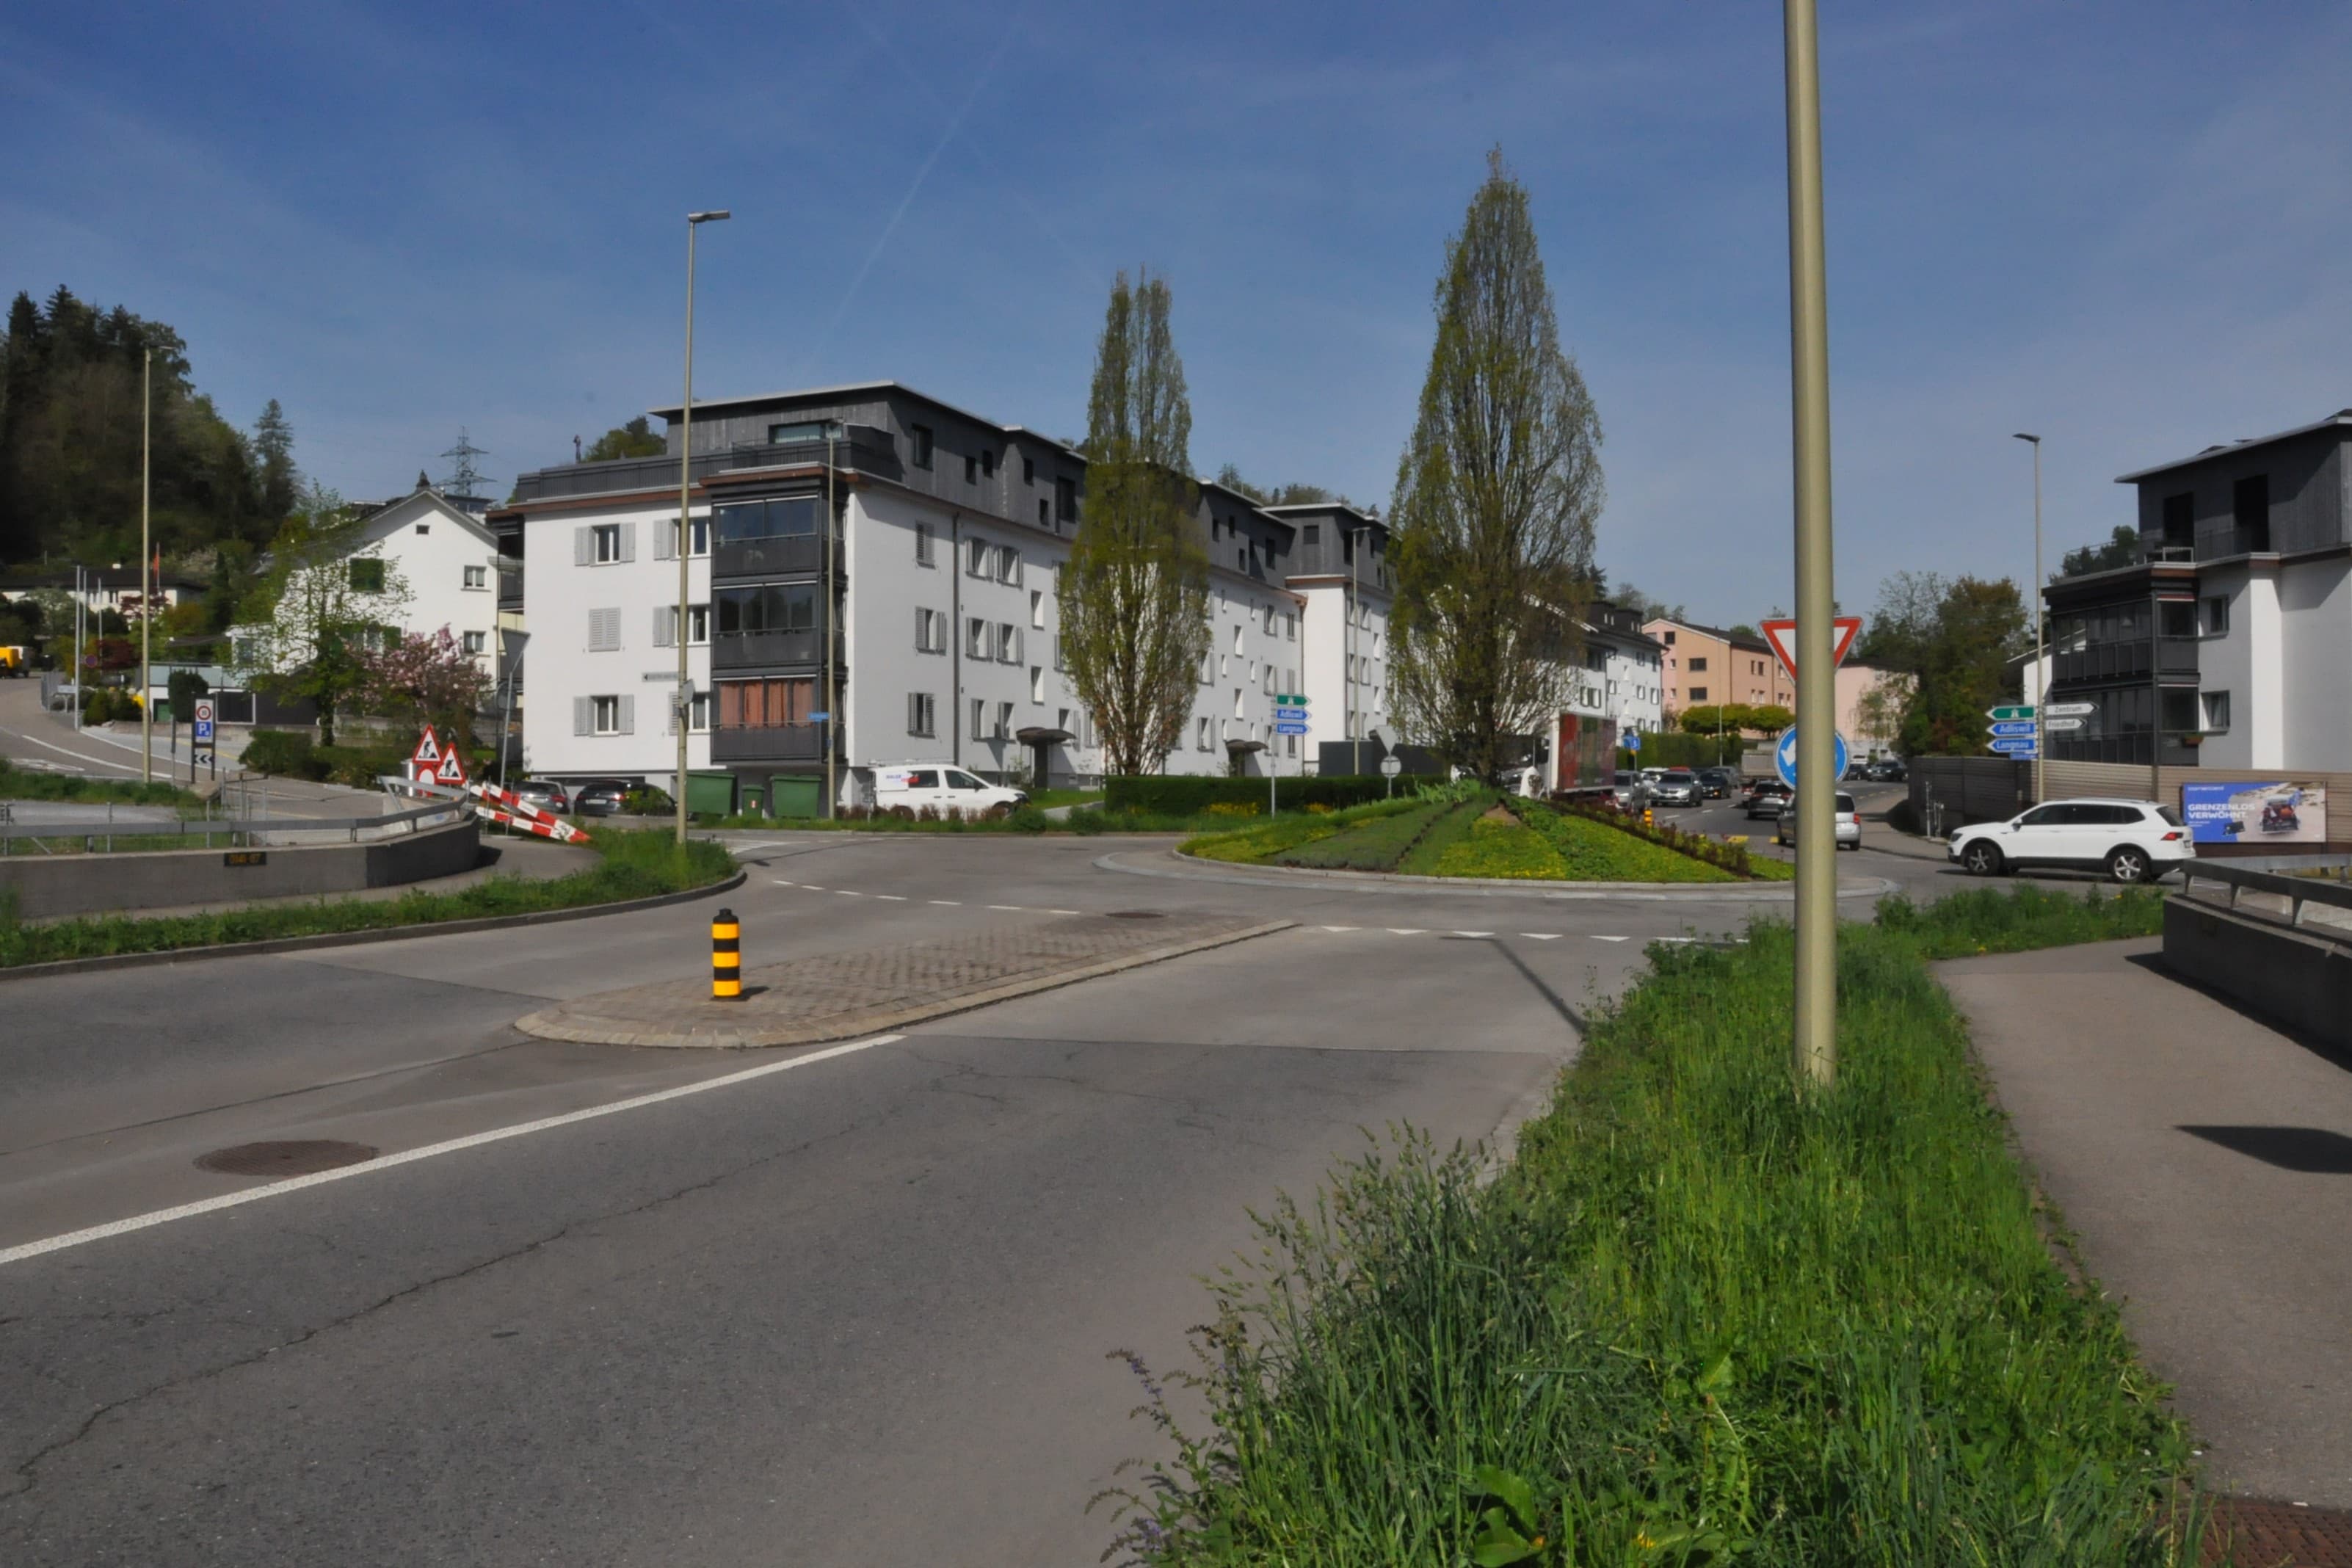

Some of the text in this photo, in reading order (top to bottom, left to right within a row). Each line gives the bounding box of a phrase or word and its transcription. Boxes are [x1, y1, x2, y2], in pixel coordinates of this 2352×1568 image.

[1280, 710, 1303, 718] Adliswil
[1999, 723, 2030, 733] Adliswil
[2048, 720, 2076, 728] Friedhof
[1279, 725, 1304, 733] Langnau
[1996, 739, 2029, 751] Langnau
[2188, 803, 2256, 811] GRENZENLOS
[2188, 810, 2248, 819] VERWÖHNT.
